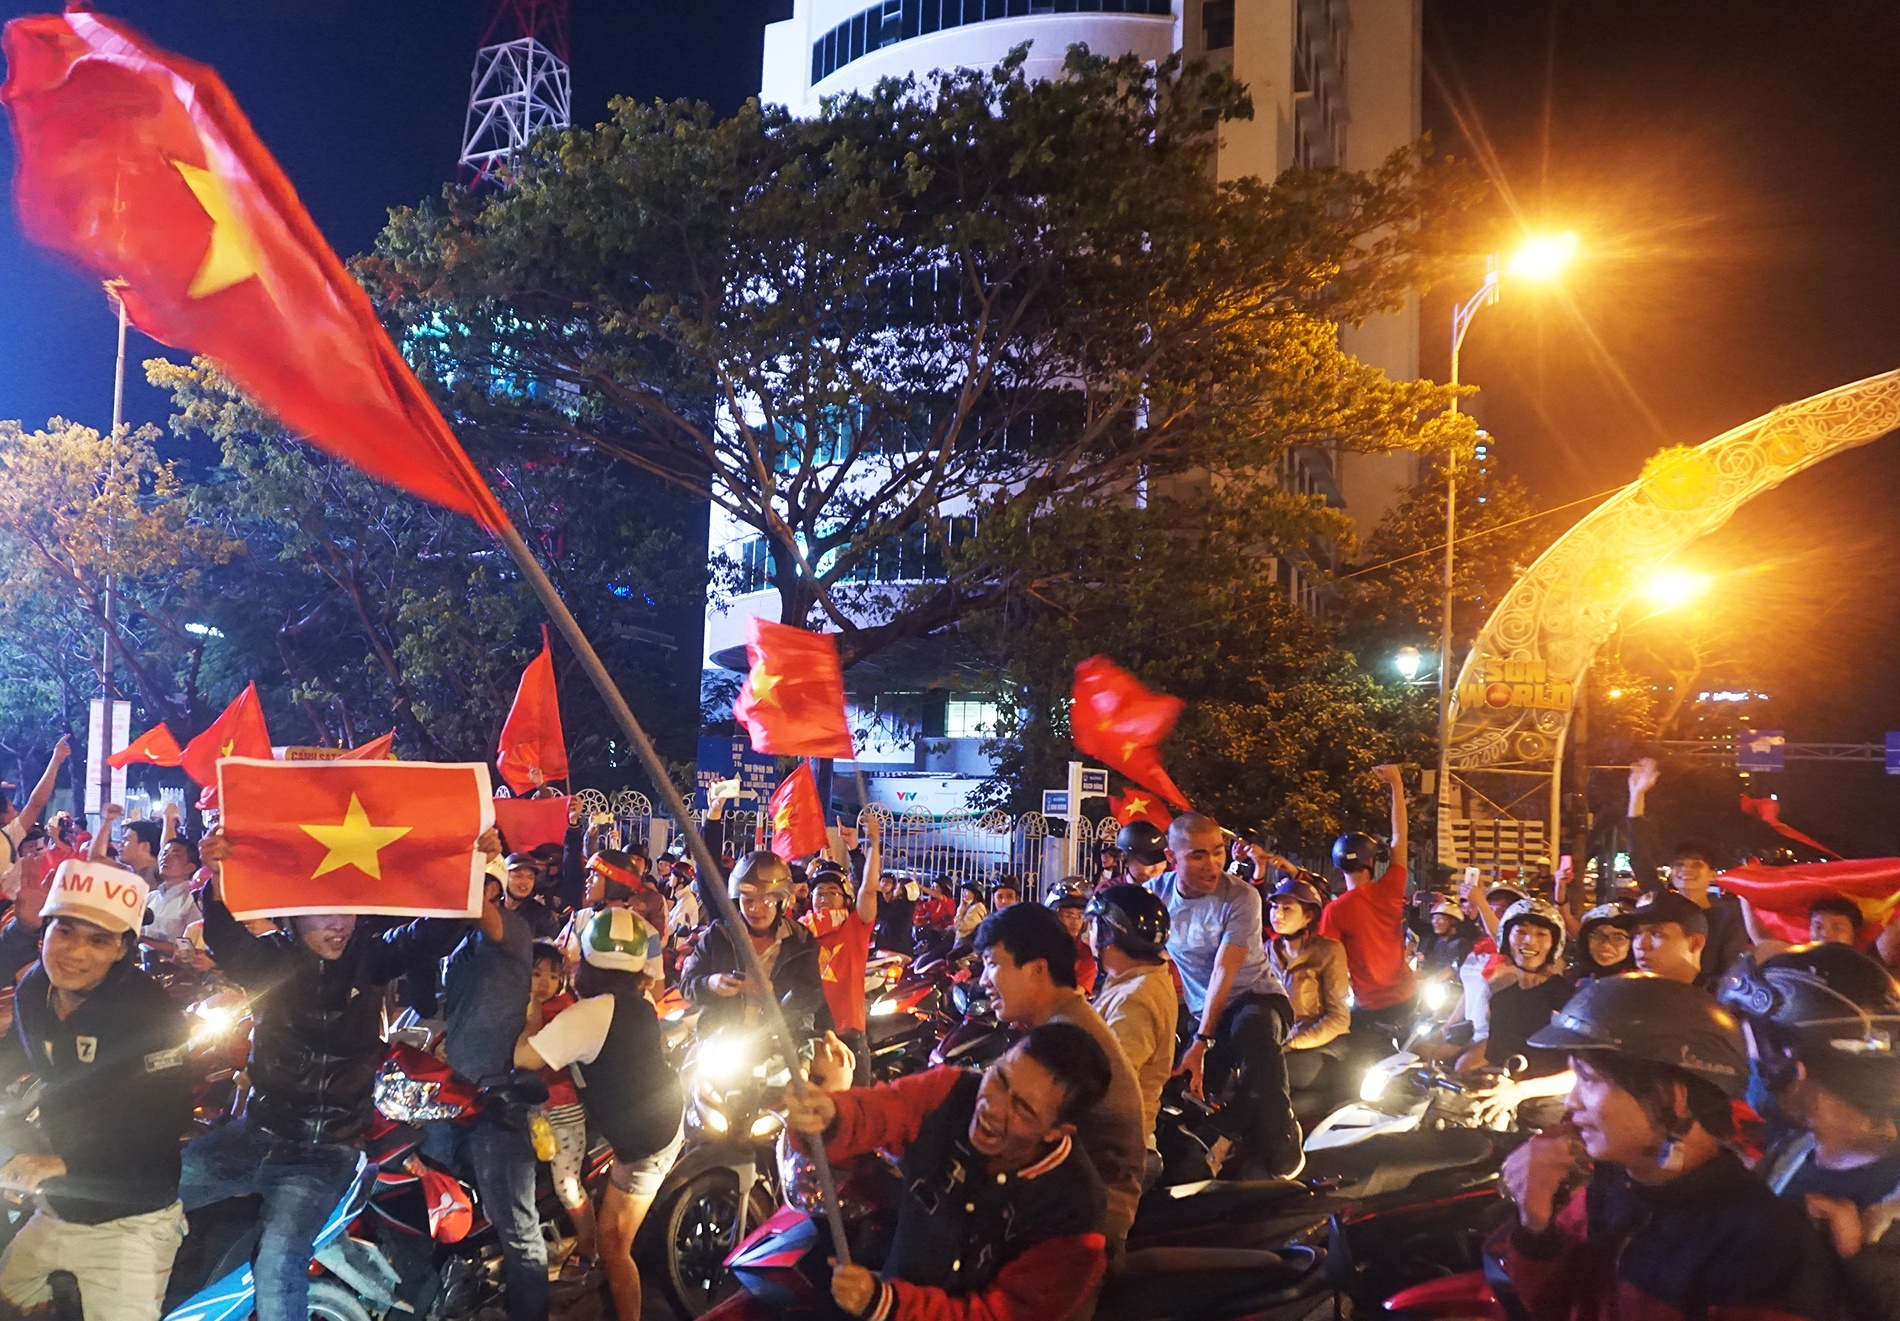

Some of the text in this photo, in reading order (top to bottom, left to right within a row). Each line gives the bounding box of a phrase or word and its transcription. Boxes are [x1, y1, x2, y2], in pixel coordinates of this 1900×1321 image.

[1485, 659, 1547, 682] SUN
[1459, 683, 1573, 711] WORLD
[896, 791, 917, 801] VTV
[104, 880, 138, 908] VÔ
[80, 1042, 92, 1057] 7
